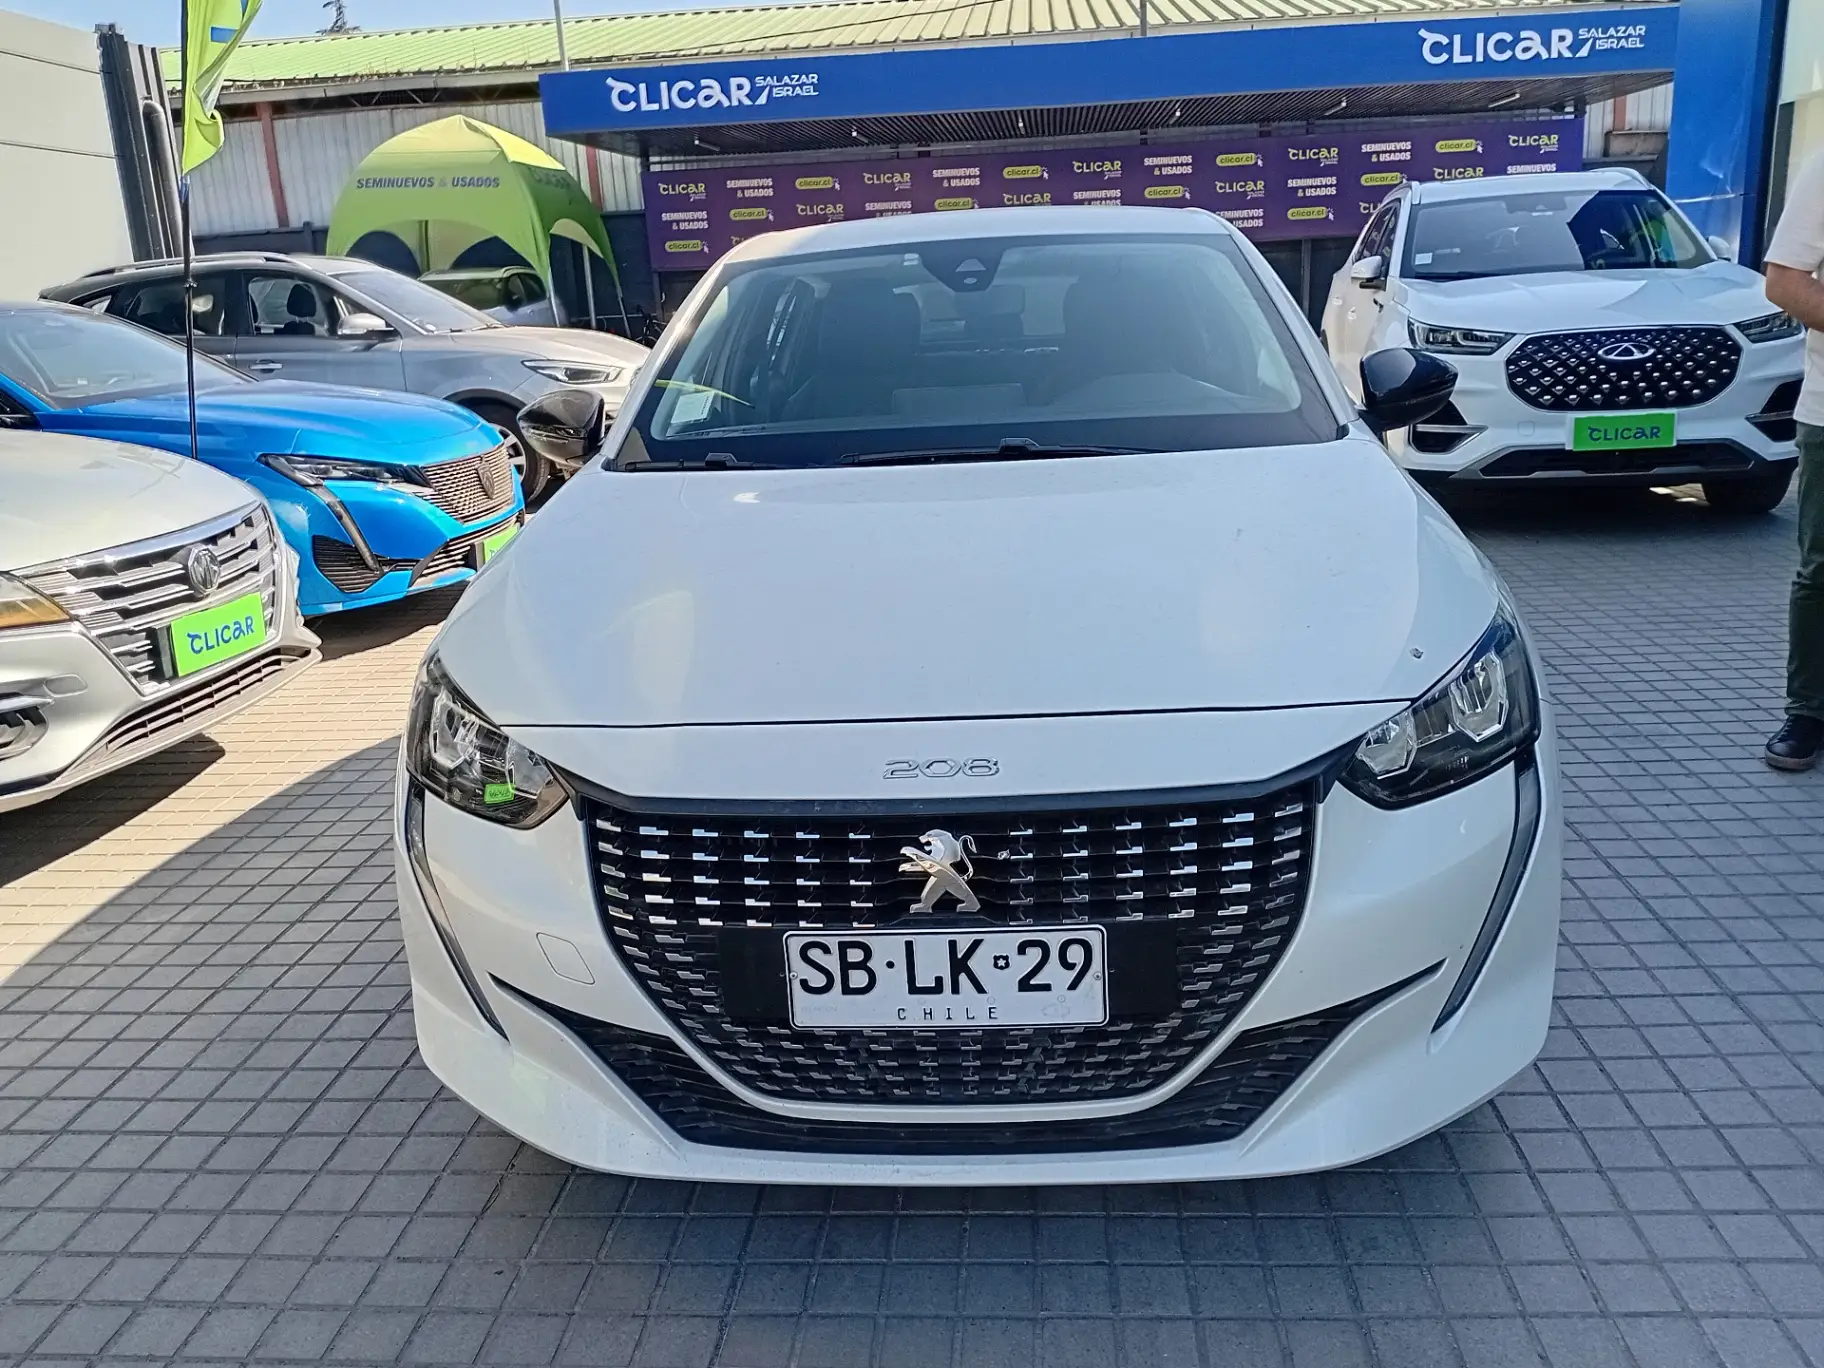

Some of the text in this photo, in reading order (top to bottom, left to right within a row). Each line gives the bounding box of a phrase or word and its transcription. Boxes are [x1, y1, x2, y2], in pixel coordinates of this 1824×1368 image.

[1578, 25, 1646, 39] SALAZAR
[1595, 37, 1645, 50] ISRAEL
[754, 73, 819, 87] SALAZAR
[771, 86, 819, 98] ISRAEL
[1361, 142, 1412, 152] SEMINUEVOS
[1439, 141, 1473, 150] clicar.cl
[1144, 155, 1193, 166] SEMINUEVOS
[1220, 154, 1253, 164] clicar.cl
[1379, 152, 1411, 161] USADOS
[932, 167, 980, 178] SEMINUEVOS
[1006, 168, 1039, 176] clicar.cl
[1161, 165, 1193, 175] USADOS
[1507, 163, 1556, 174] SEMINUEVOS
[356, 176, 436, 189] SEMINUEVOS
[451, 176, 500, 188] USADOS
[726, 178, 773, 188] SEMINUEVOS
[950, 178, 980, 187] USADOS
[1287, 176, 1337, 188] SEMINUEVOS
[1364, 174, 1398, 184] clicar.cl
[744, 188, 774, 197] USADOS
[1073, 189, 1121, 200] SEMINUEVOS
[1147, 186, 1181, 196] clicar.cl
[1305, 186, 1337, 196] USADOS
[865, 200, 912, 211] SEMINUEVOS
[661, 211, 708, 222] SEMINUEVOS
[1291, 209, 1325, 217] clicar.cl
[679, 220, 708, 230] USADOS
[883, 757, 1000, 779] 208
[897, 1007, 998, 1021] CHILE
